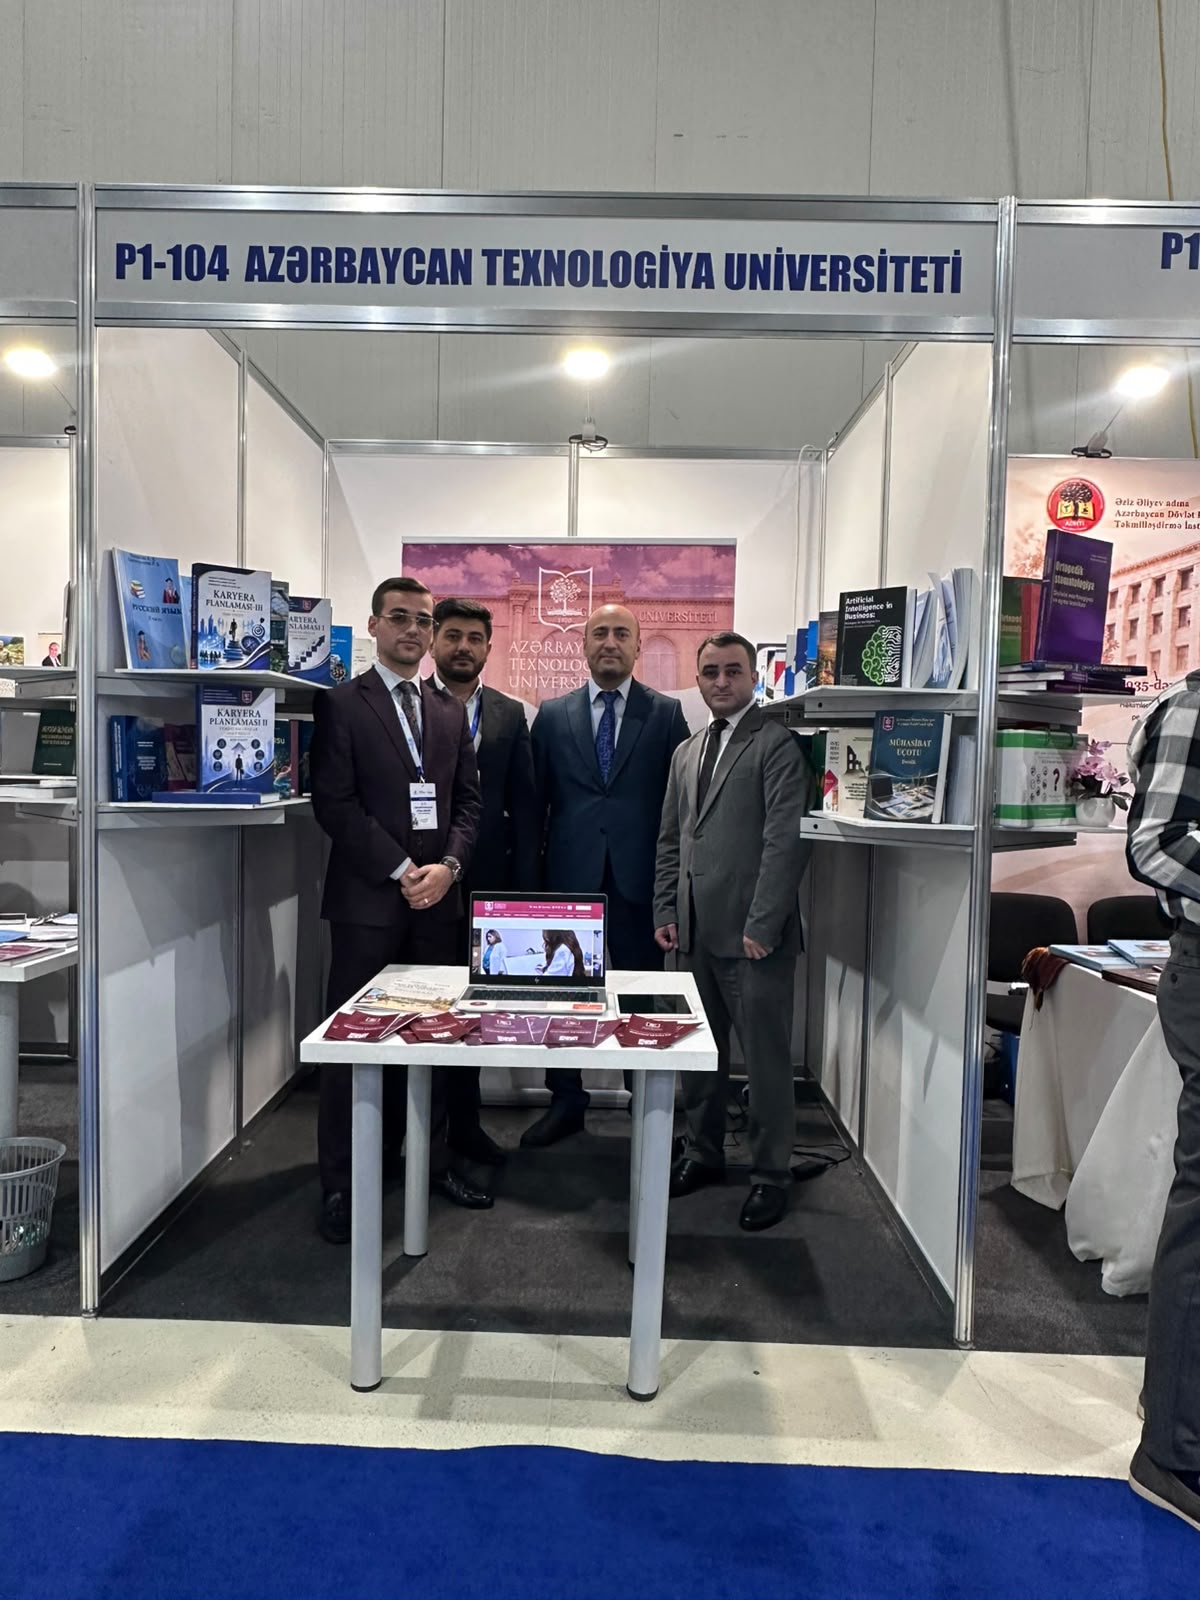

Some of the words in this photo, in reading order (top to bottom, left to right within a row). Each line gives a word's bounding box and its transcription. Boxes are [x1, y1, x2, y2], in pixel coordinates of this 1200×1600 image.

[1160, 231, 1200, 270] P1
[115, 242, 229, 282] P1-104
[244, 245, 472, 286] AZƏRBAYCAN
[482, 244, 715, 290] TEXNOLOGİYA
[724, 246, 962, 294] UNİVERSİTETİ
[1115, 498, 1134, 506] Əziz
[1136, 498, 1164, 508] Əliyev
[1166, 499, 1190, 507] adına
[1115, 509, 1165, 519] Azərbaycan
[1167, 510, 1195, 518] Dövlət
[1114, 519, 1182, 530] Təkmilləşdirmə
[213, 589, 256, 602] KARYERA
[845, 595, 874, 605] Artificial
[845, 603, 885, 613] Intelligence
[886, 601, 893, 609] in
[289, 616, 318, 624] ARYERA
[639, 609, 718, 624] UNİVERSİTETİ
[289, 623, 321, 631] NLAMASI
[509, 640, 583, 654] AZƏRBAY
[509, 658, 589, 671] TEXNOLO
[217, 708, 262, 718] KARYERA
[209, 717, 261, 726] PLANLAMASI
[888, 737, 933, 747] MÜHASİBAT
[896, 748, 922, 757] UÇOTU
